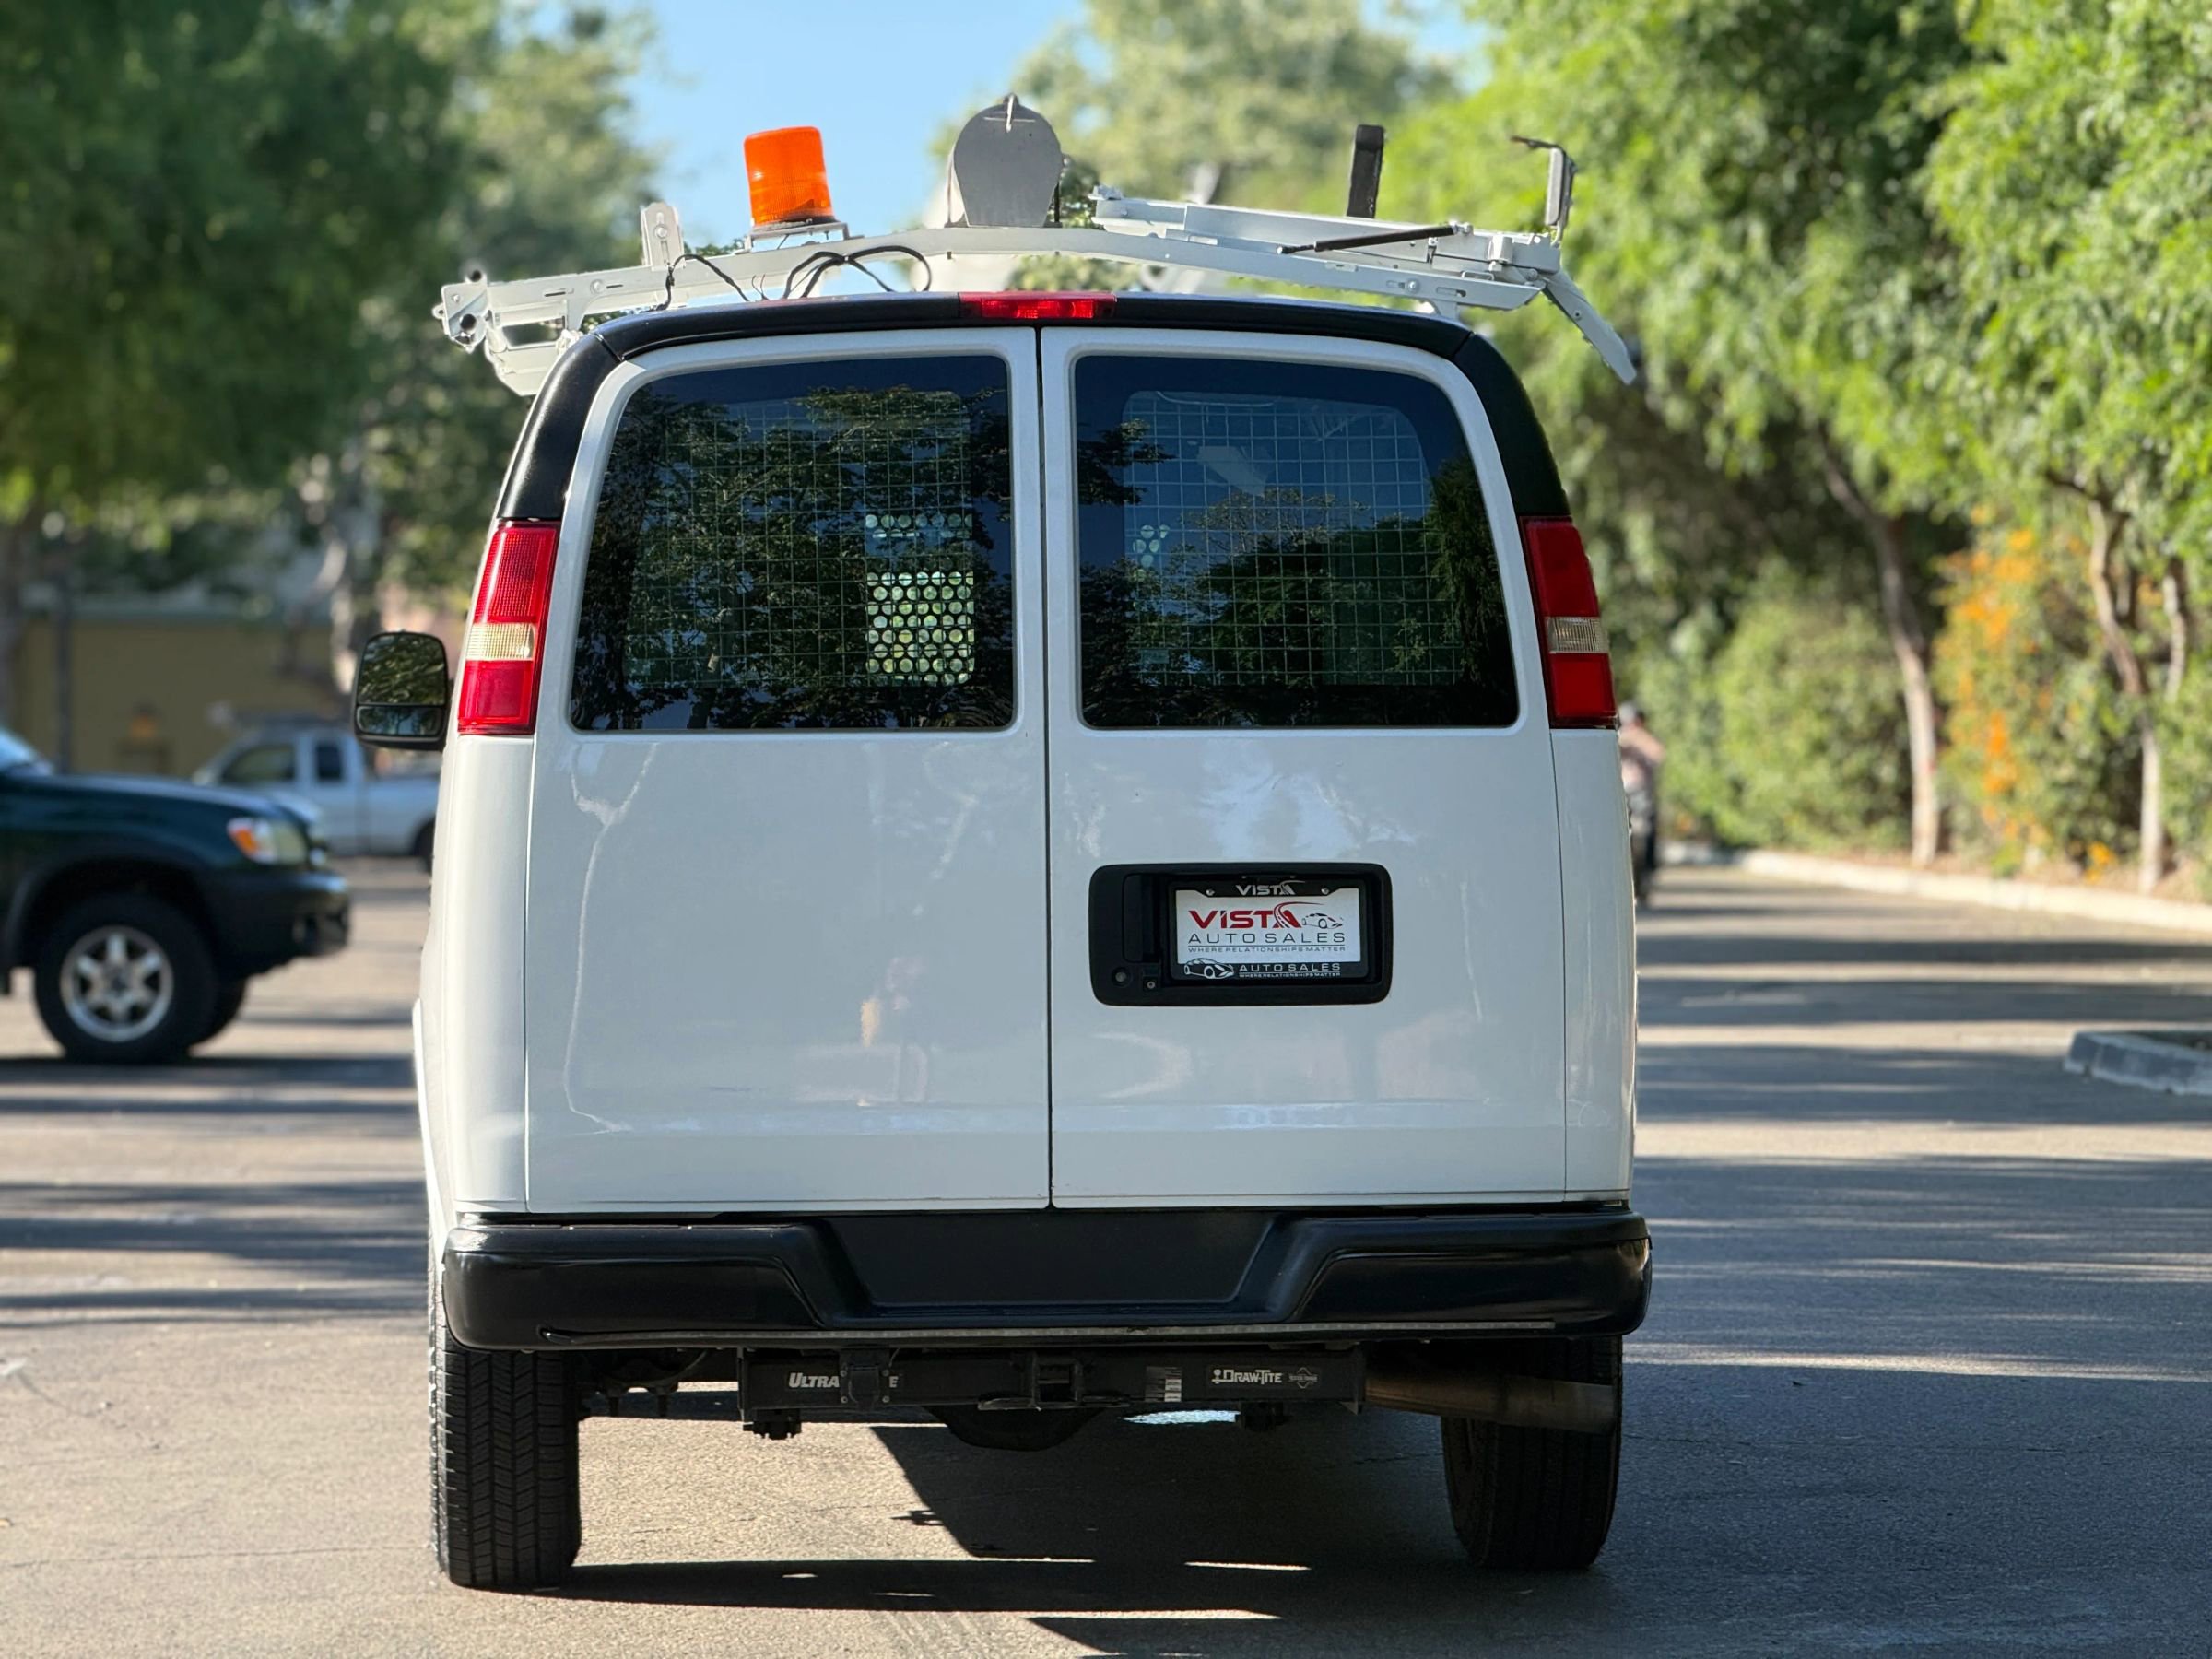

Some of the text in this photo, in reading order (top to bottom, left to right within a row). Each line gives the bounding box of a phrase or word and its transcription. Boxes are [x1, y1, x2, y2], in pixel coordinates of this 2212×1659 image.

[1236, 884, 1296, 896] VISTA
[1188, 909, 1302, 929] VISTA
[1188, 932, 1346, 944] AUTO SALES
[1239, 962, 1341, 972] AUTO SALES
